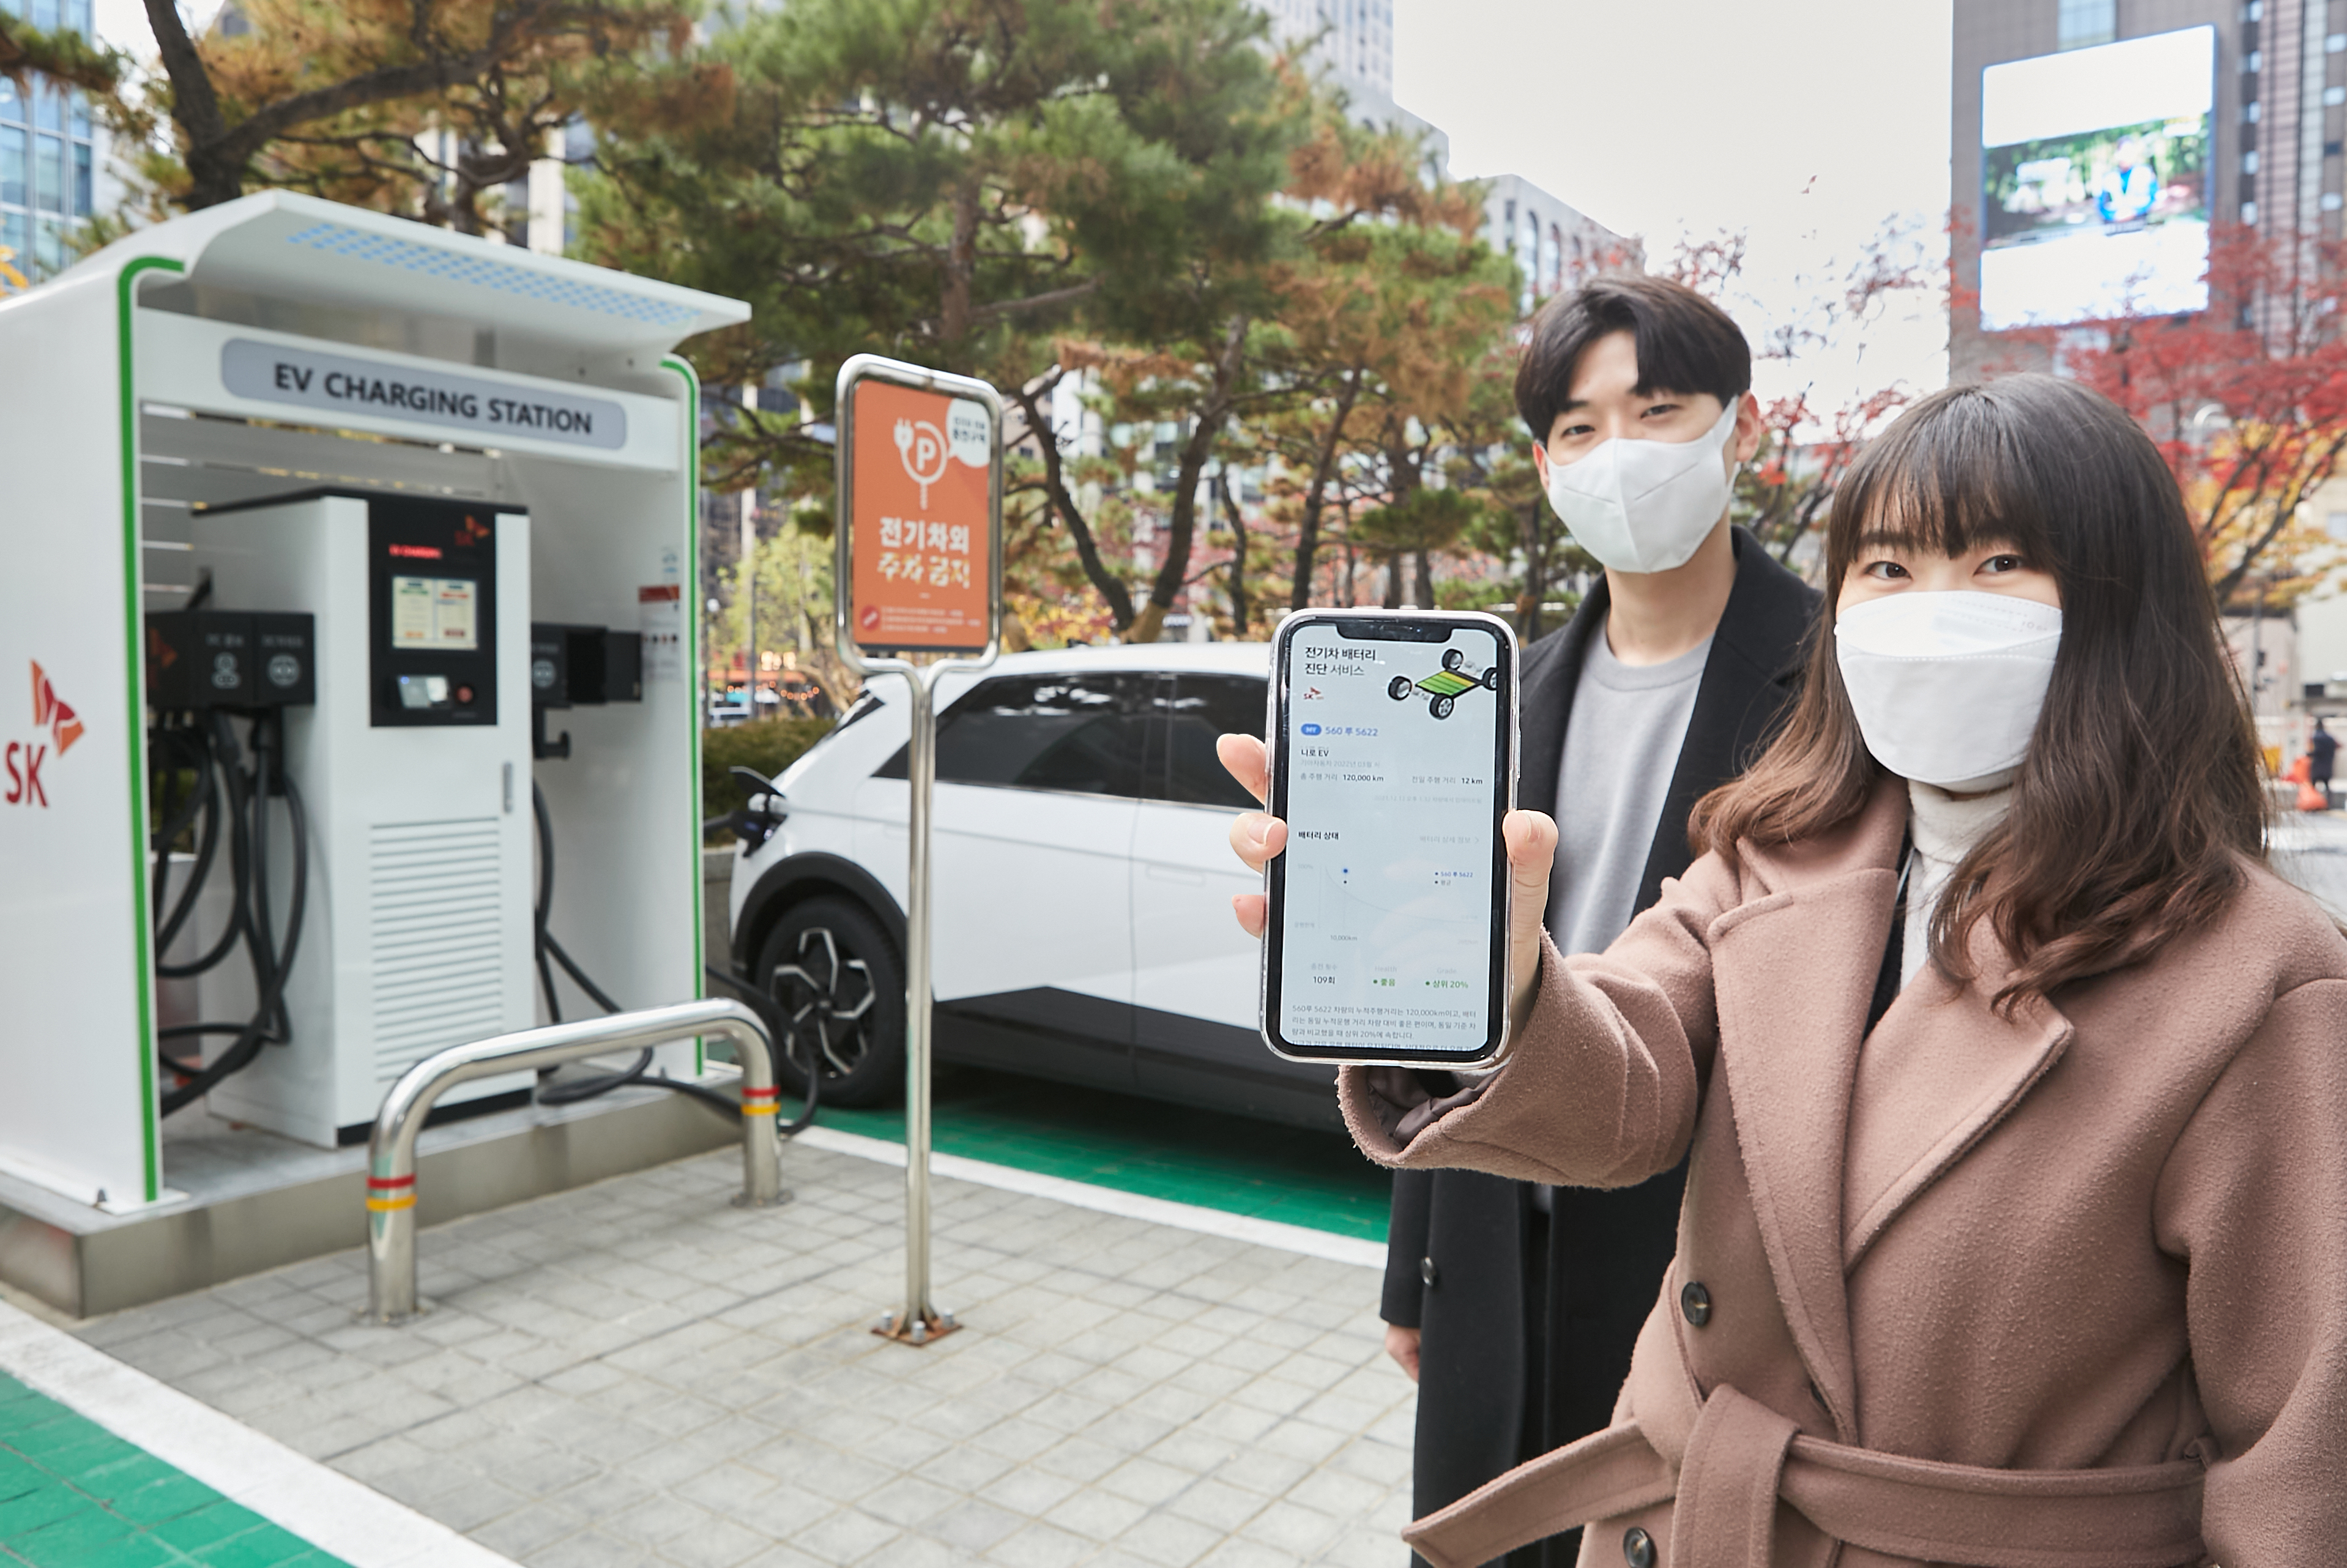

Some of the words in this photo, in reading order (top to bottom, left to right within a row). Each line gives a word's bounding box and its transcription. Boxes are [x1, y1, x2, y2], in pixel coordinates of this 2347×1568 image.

[274, 363, 312, 392] EV
[324, 372, 478, 418] CHARGING
[487, 398, 592, 434] STATION
[879, 516, 970, 555] 전기차외
[877, 551, 924, 583] 주차
[928, 555, 970, 589] 금지
[1305, 647, 1339, 660] 전기차
[1342, 648, 1376, 661] 배터리
[1305, 663, 1327, 675] 진단
[1330, 664, 1365, 676] 서비스
[1355, 728, 1378, 737] 5622
[1301, 748, 1316, 757] 니로
[1318, 749, 1329, 757] EV
[6, 741, 48, 808] SK
[1298, 831, 1321, 839] 배터리
[1323, 831, 1339, 840] 상태
[1313, 976, 1336, 984] 109회
[1432, 979, 1448, 989] 상위
[1356, 1007, 1404, 1016] 누적주행거리는
[1406, 1009, 1460, 1018] 120,000km이고,
